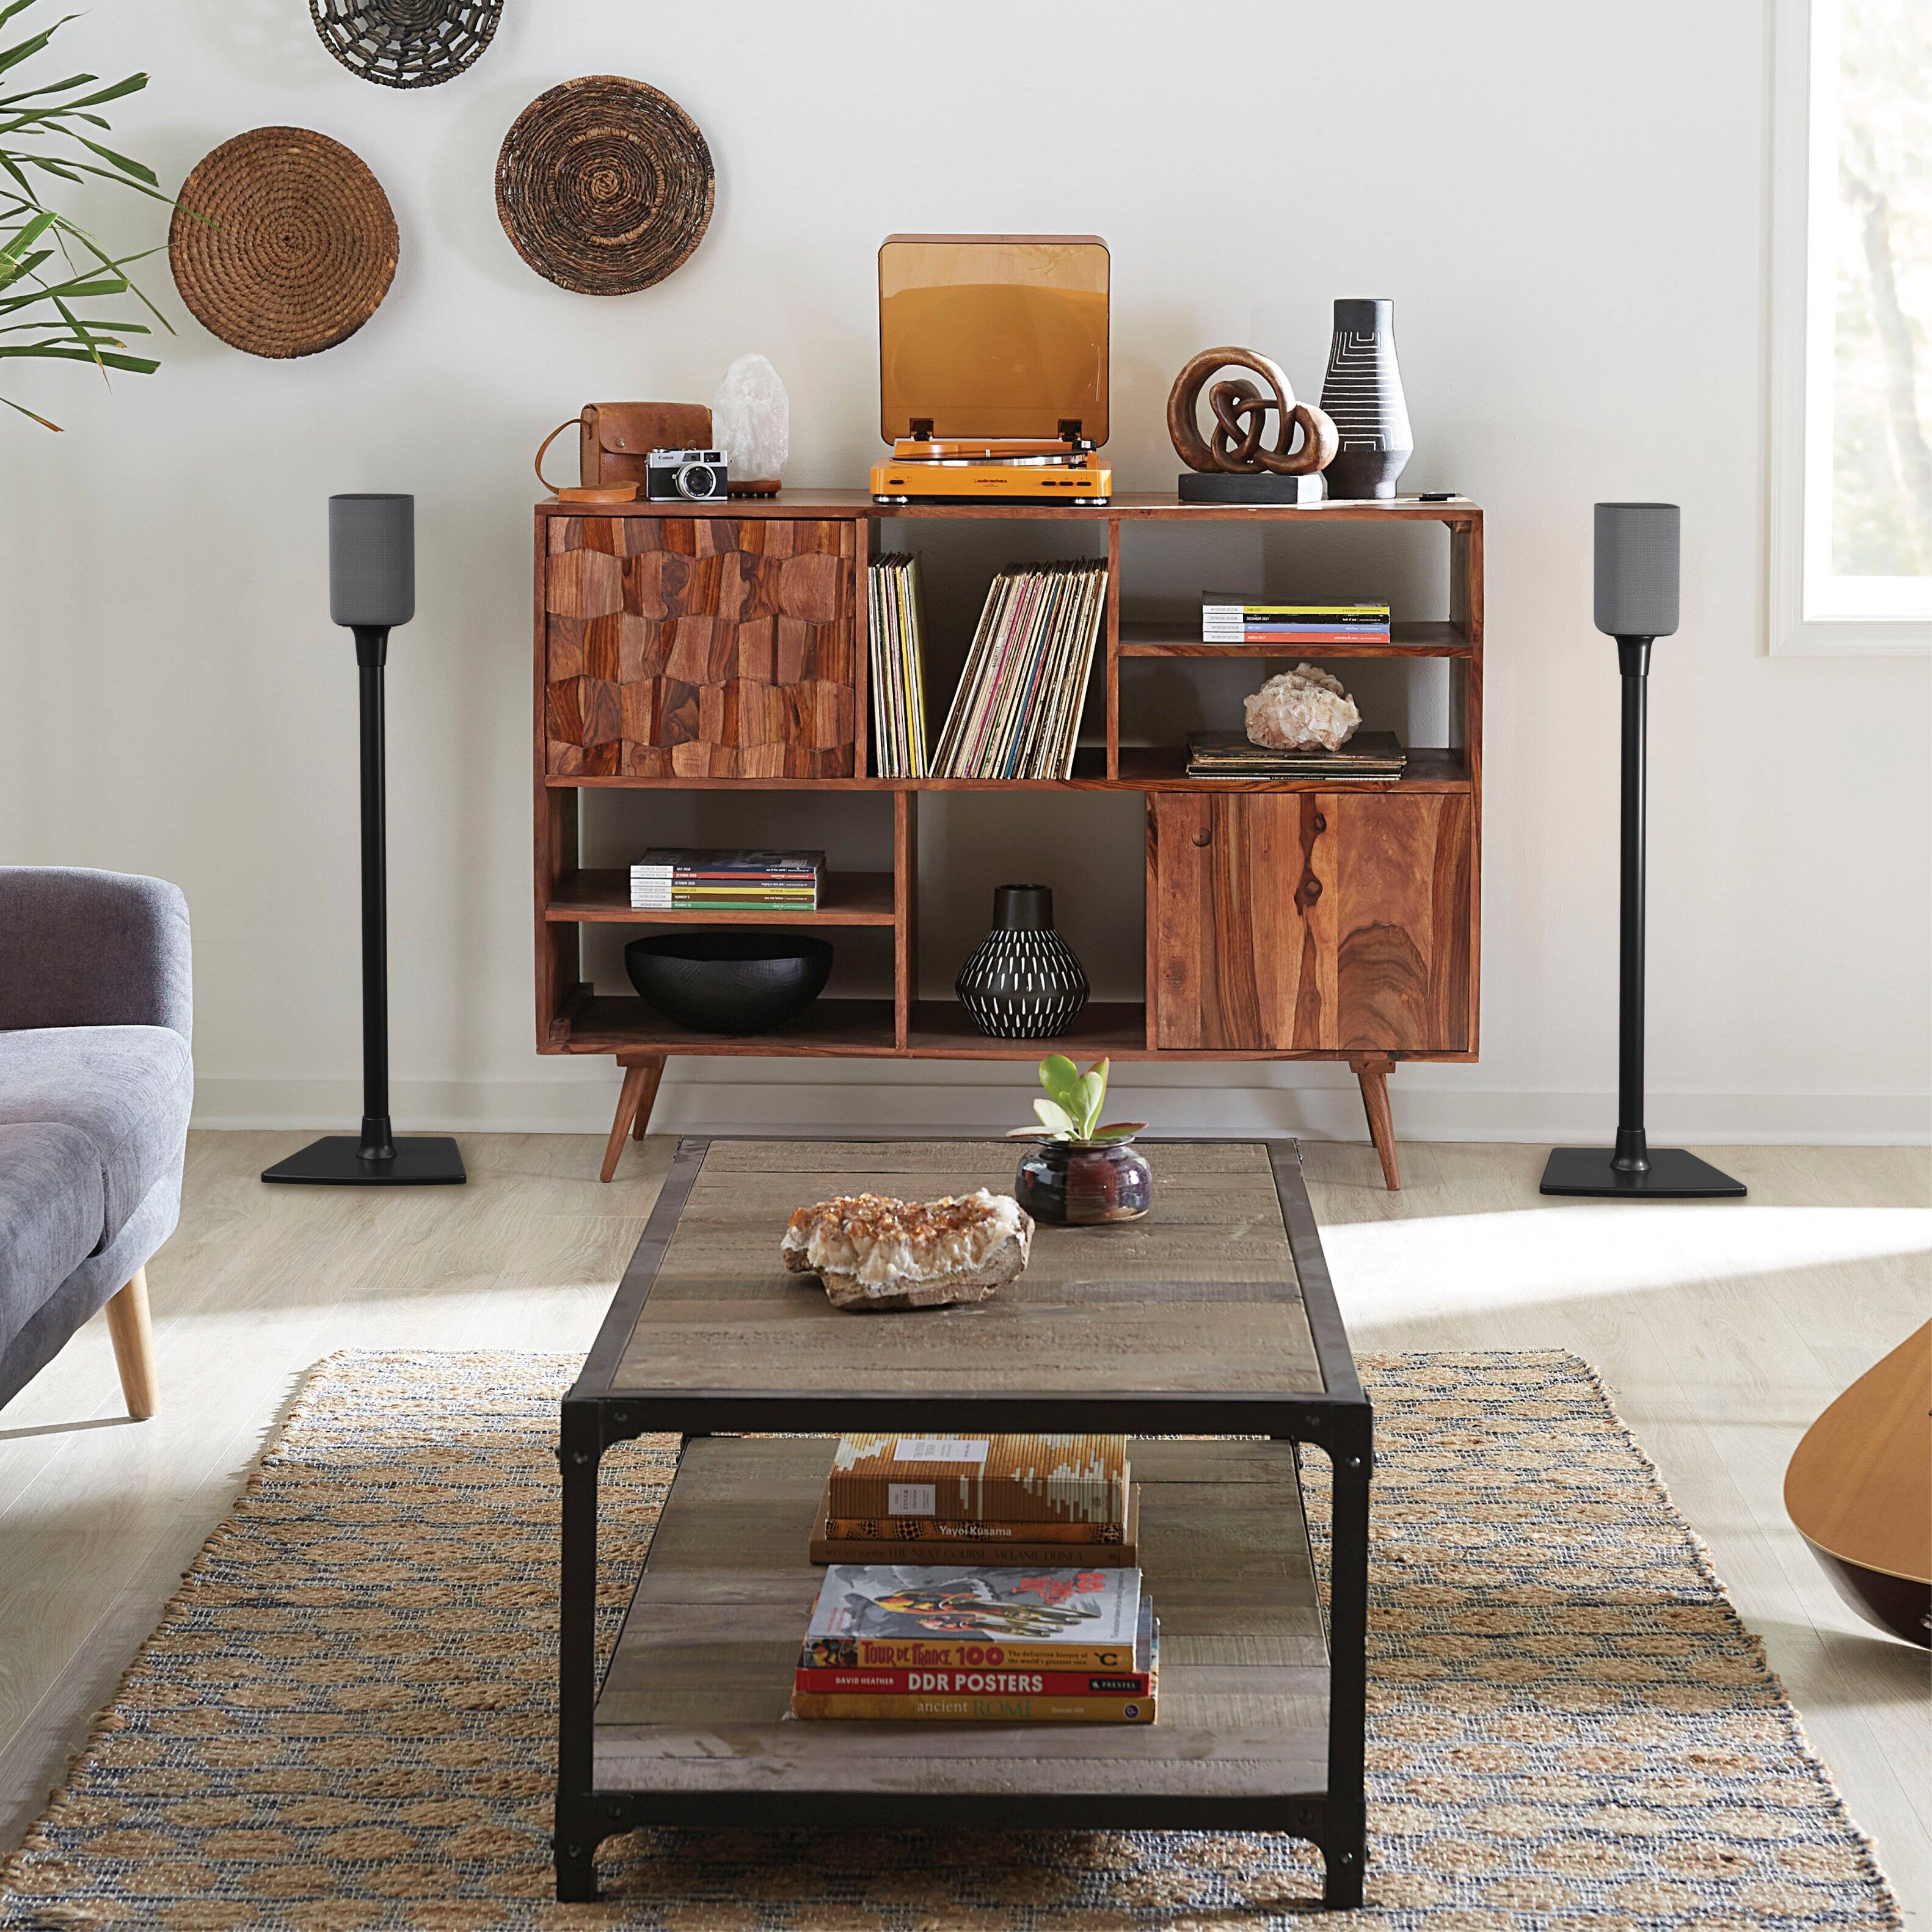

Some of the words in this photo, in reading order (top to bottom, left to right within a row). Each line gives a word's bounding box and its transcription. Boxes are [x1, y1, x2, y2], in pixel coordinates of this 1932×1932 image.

[939, 1525, 968, 1537] Yayoi
[969, 1526, 1012, 1537] Kusama
[943, 1550, 986, 1559] COURSE
[994, 1551, 1038, 1560] MELANIE
[955, 1646, 1005, 1666] 100
[908, 1673, 949, 1691] DDR
[954, 1674, 1043, 1693] POSTERS
[1101, 1680, 1136, 1690] PRESTEL
[917, 1699, 969, 1713] ancient
[972, 1700, 1031, 1716] ROME
